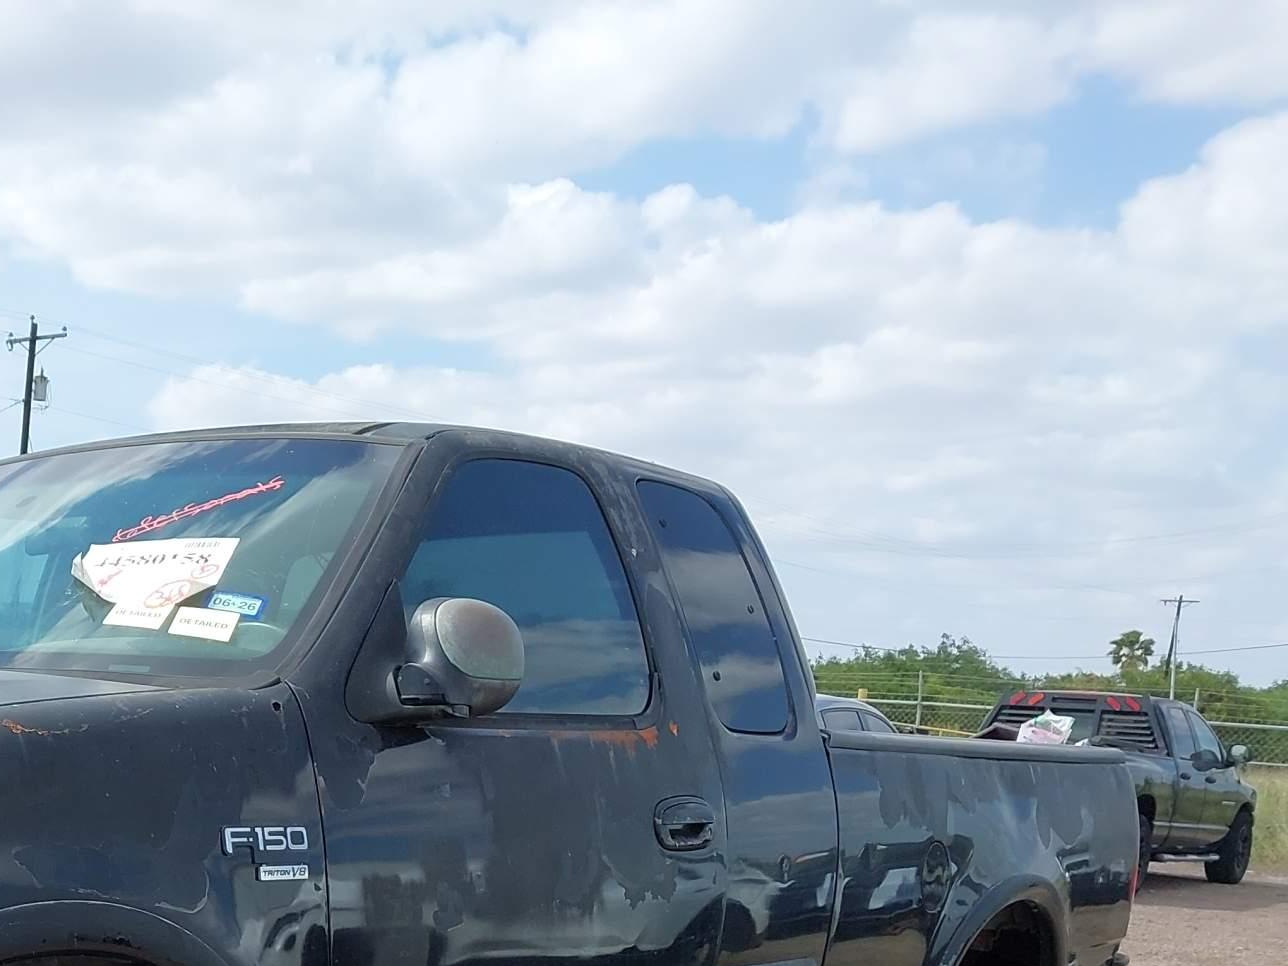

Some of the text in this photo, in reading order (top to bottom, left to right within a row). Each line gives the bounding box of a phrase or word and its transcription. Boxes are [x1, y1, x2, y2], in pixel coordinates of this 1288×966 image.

[178, 617, 230, 629] DETAILED
[262, 866, 307, 878] TRITON V8
